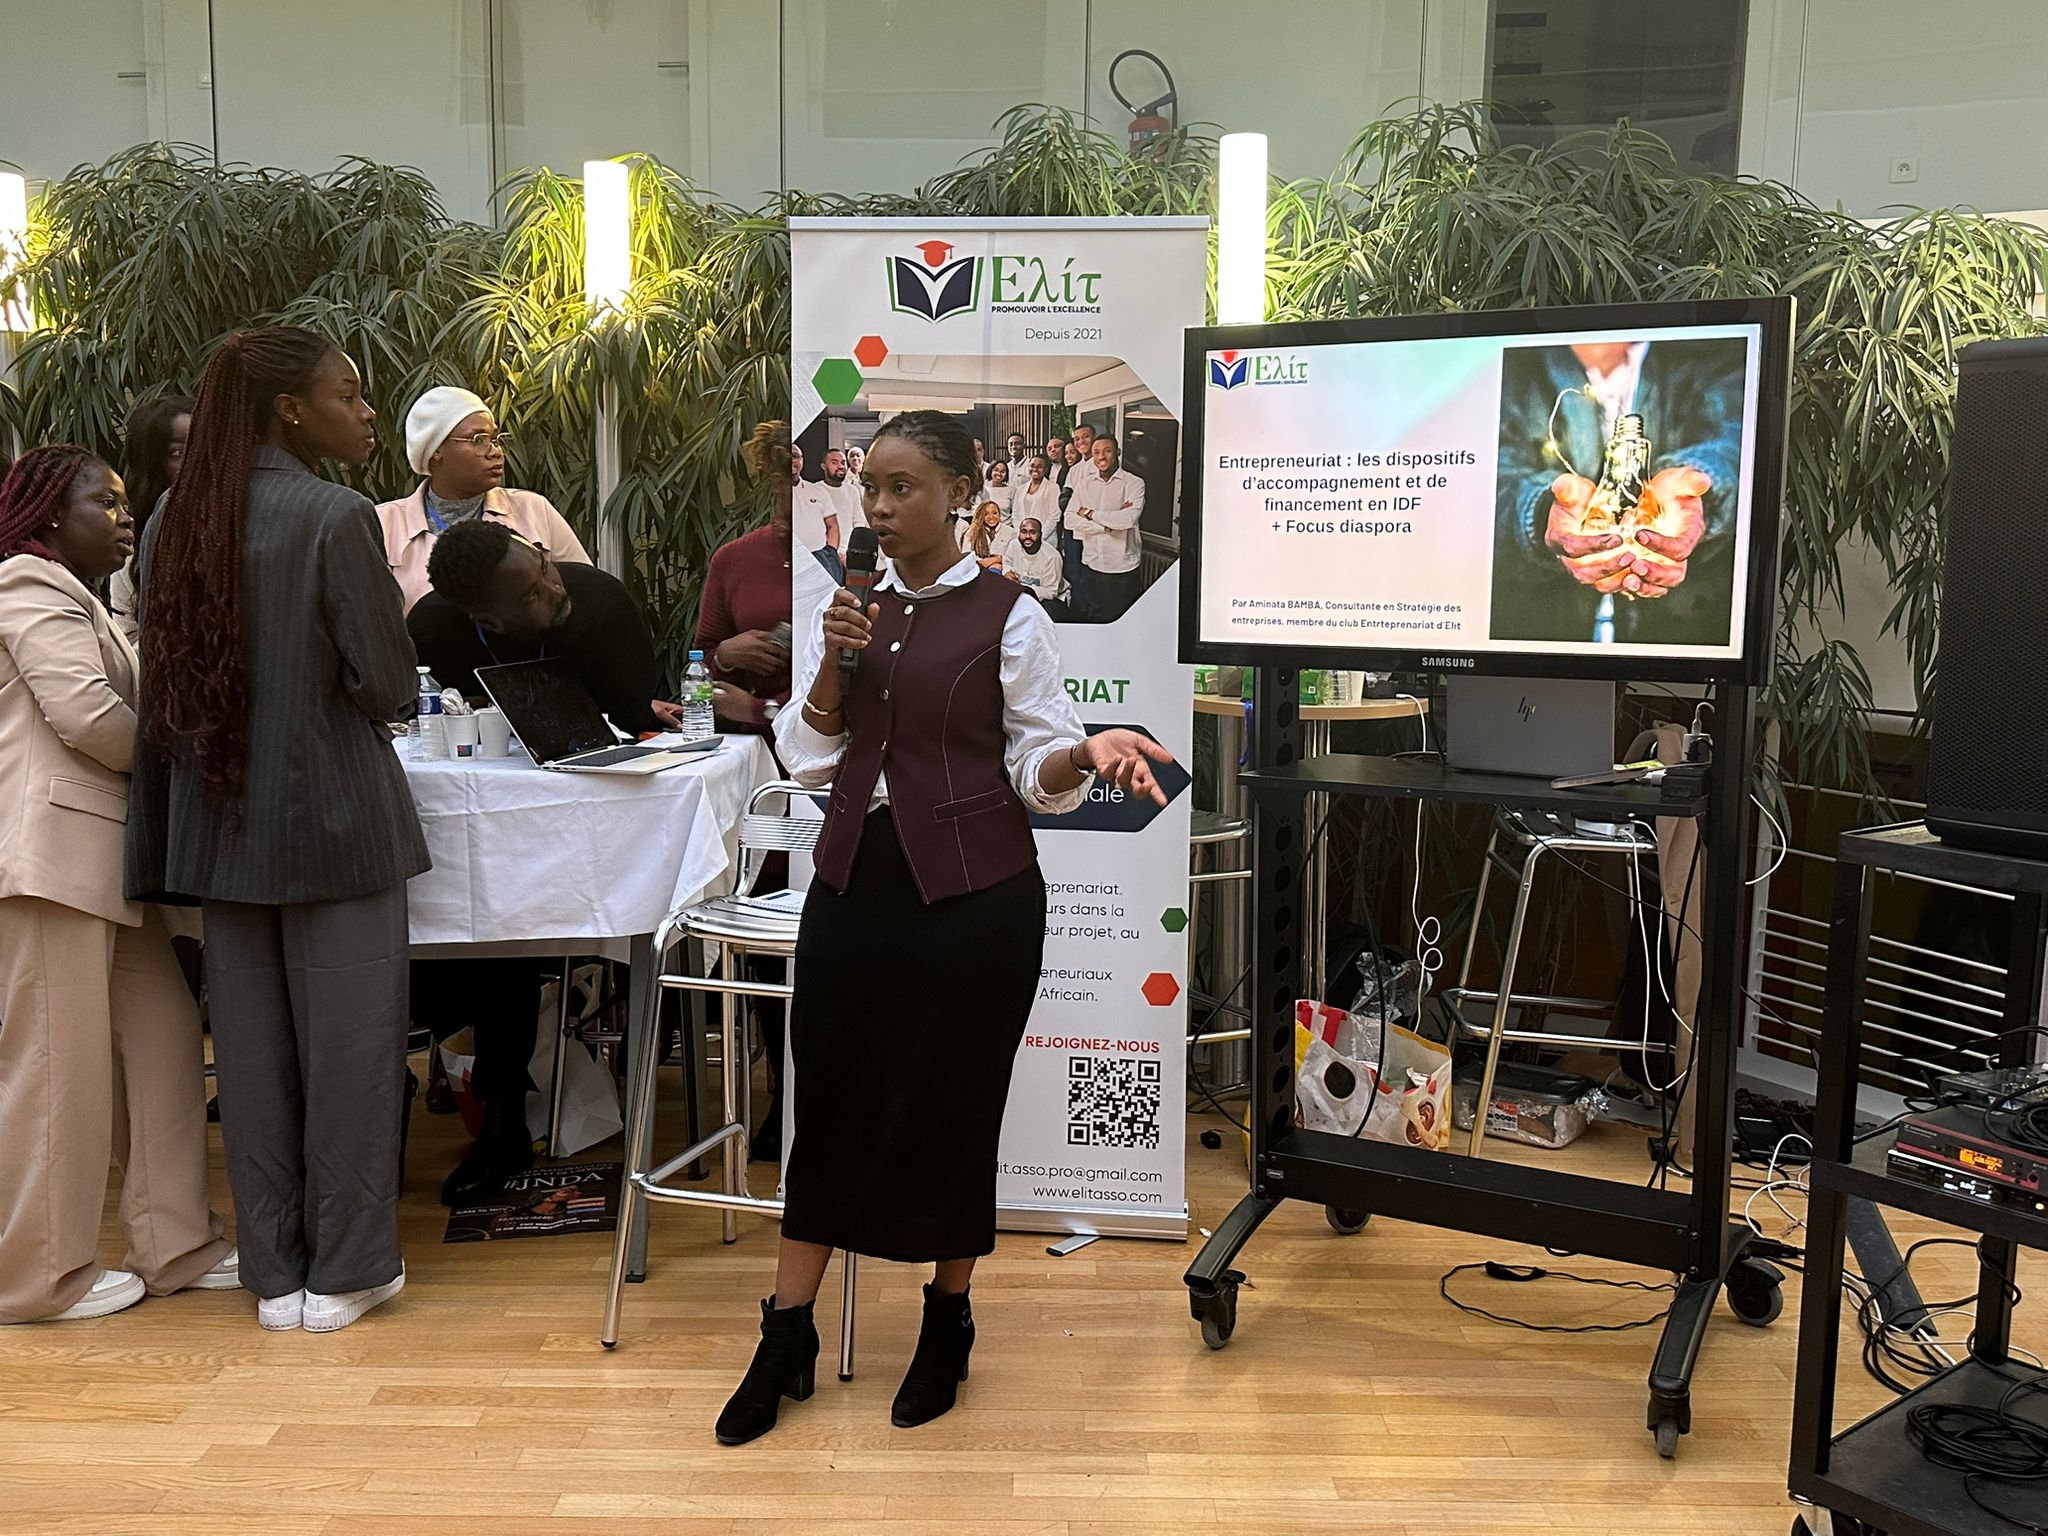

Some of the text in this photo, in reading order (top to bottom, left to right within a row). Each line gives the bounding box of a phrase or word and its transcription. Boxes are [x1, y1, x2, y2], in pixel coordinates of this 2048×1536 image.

[991, 305, 1101, 314] PROMOUVOIR L'EXCELLENCE
[1025, 327, 1102, 341] Depuis 2021
[1219, 453, 1342, 472] Entrepreneuriat
[1357, 452, 1381, 467] les
[1386, 450, 1476, 469] dispositifs
[1242, 473, 1448, 493] d'accompagnement et de
[1264, 496, 1422, 512] financement en IDF
[1271, 518, 1412, 537] + Focus diaspora
[1232, 599, 1462, 614] Par Aminata BAMBA, Consultante en Stratégie des
[1231, 616, 1284, 627] entreprises,
[1286, 617, 1324, 627] membre
[1325, 618, 1338, 628] du
[1338, 618, 1359, 628] club
[1421, 657, 1475, 668] SAMSUNG
[1070, 903, 1107, 916] dans
[1111, 903, 1125, 917] la
[1068, 924, 1116, 940] projet,
[1120, 929, 1140, 940] au
[1039, 987, 1099, 1002] Africain.
[1025, 1035, 1160, 1053] REJOIGNEZ-NOUS
[1032, 1186, 1163, 1204] www.elitasso.com
